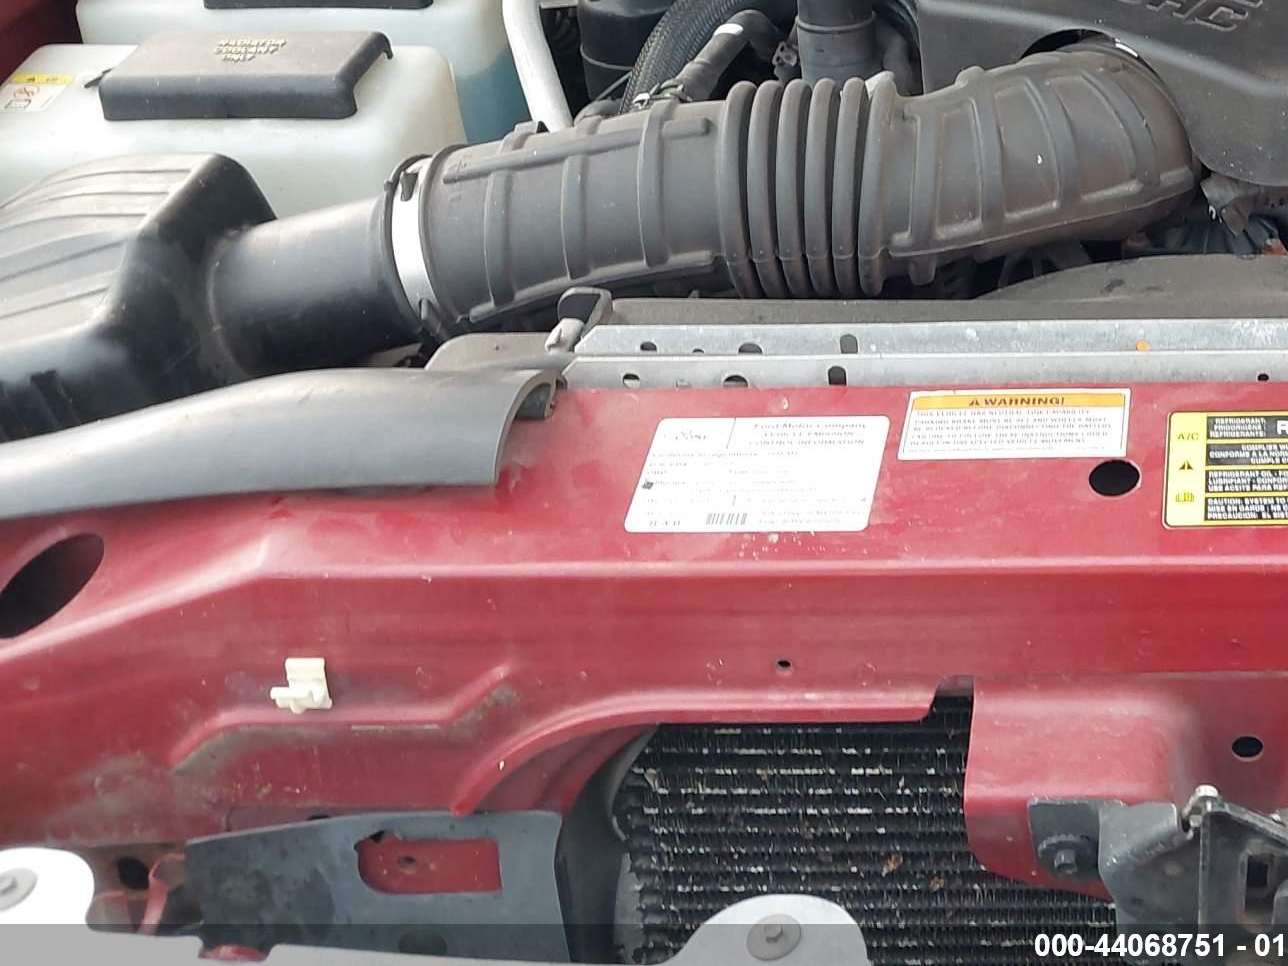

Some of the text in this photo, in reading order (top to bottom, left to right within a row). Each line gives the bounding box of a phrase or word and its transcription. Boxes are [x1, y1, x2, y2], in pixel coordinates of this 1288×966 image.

[218, 38, 287, 47] RADIATOR
[214, 46, 279, 54] COOLANT
[222, 54, 256, 62] ONLY
[984, 397, 1065, 406] WARNING!
